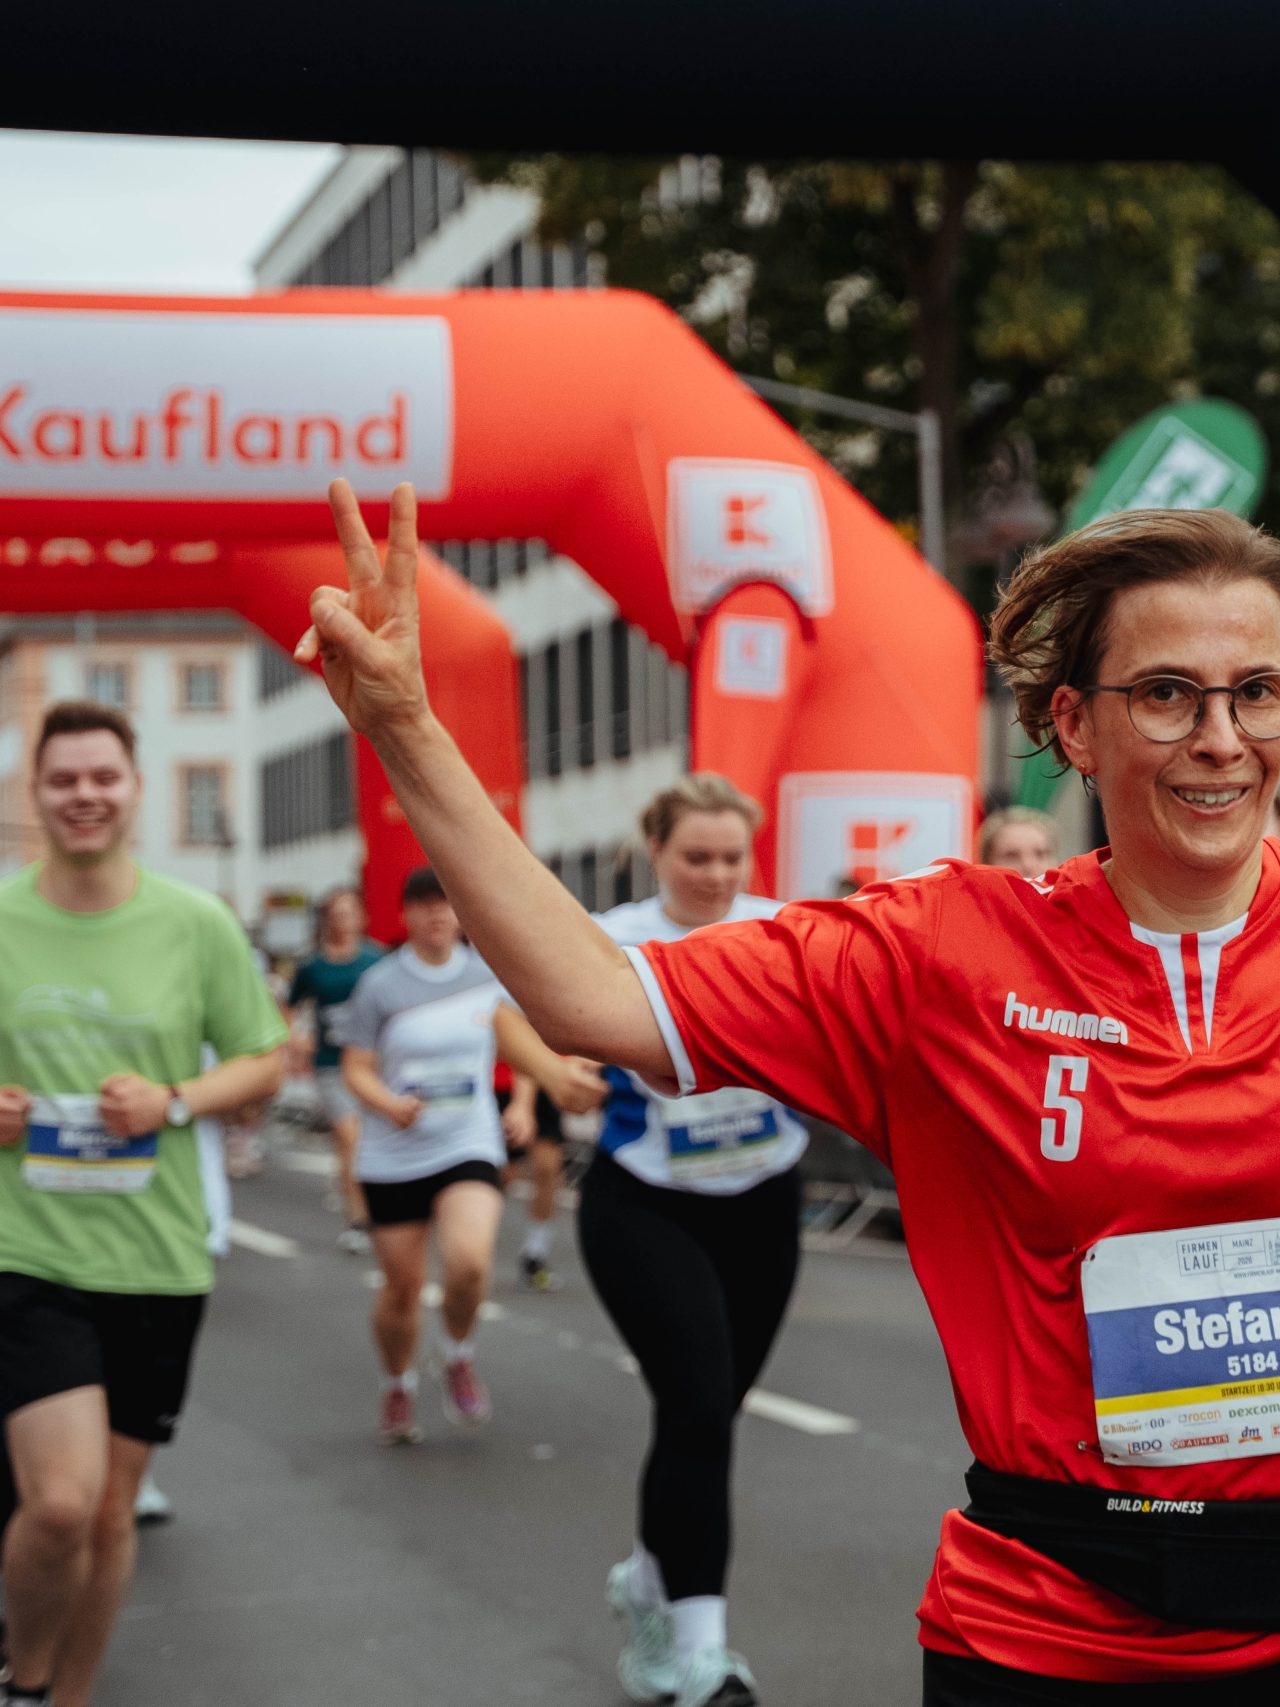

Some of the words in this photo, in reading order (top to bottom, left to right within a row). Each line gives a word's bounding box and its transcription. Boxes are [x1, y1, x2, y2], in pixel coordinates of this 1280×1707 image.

[1004, 992, 1128, 1045] hummel
[1040, 1054, 1088, 1162] 5
[1181, 1241, 1218, 1254] FIRMEN
[1232, 1238, 1253, 1249] MAINZ
[1183, 1253, 1219, 1271] LAUF
[1228, 1351, 1278, 1376] 5184
[1221, 1384, 1256, 1398] STARTZEIT
[1241, 1426, 1260, 1438] dm
[1131, 1439, 1162, 1453] BDO
[1180, 1434, 1228, 1449] BAUHAUS
[1106, 1498, 1205, 1515] BUILD&FITNESS
